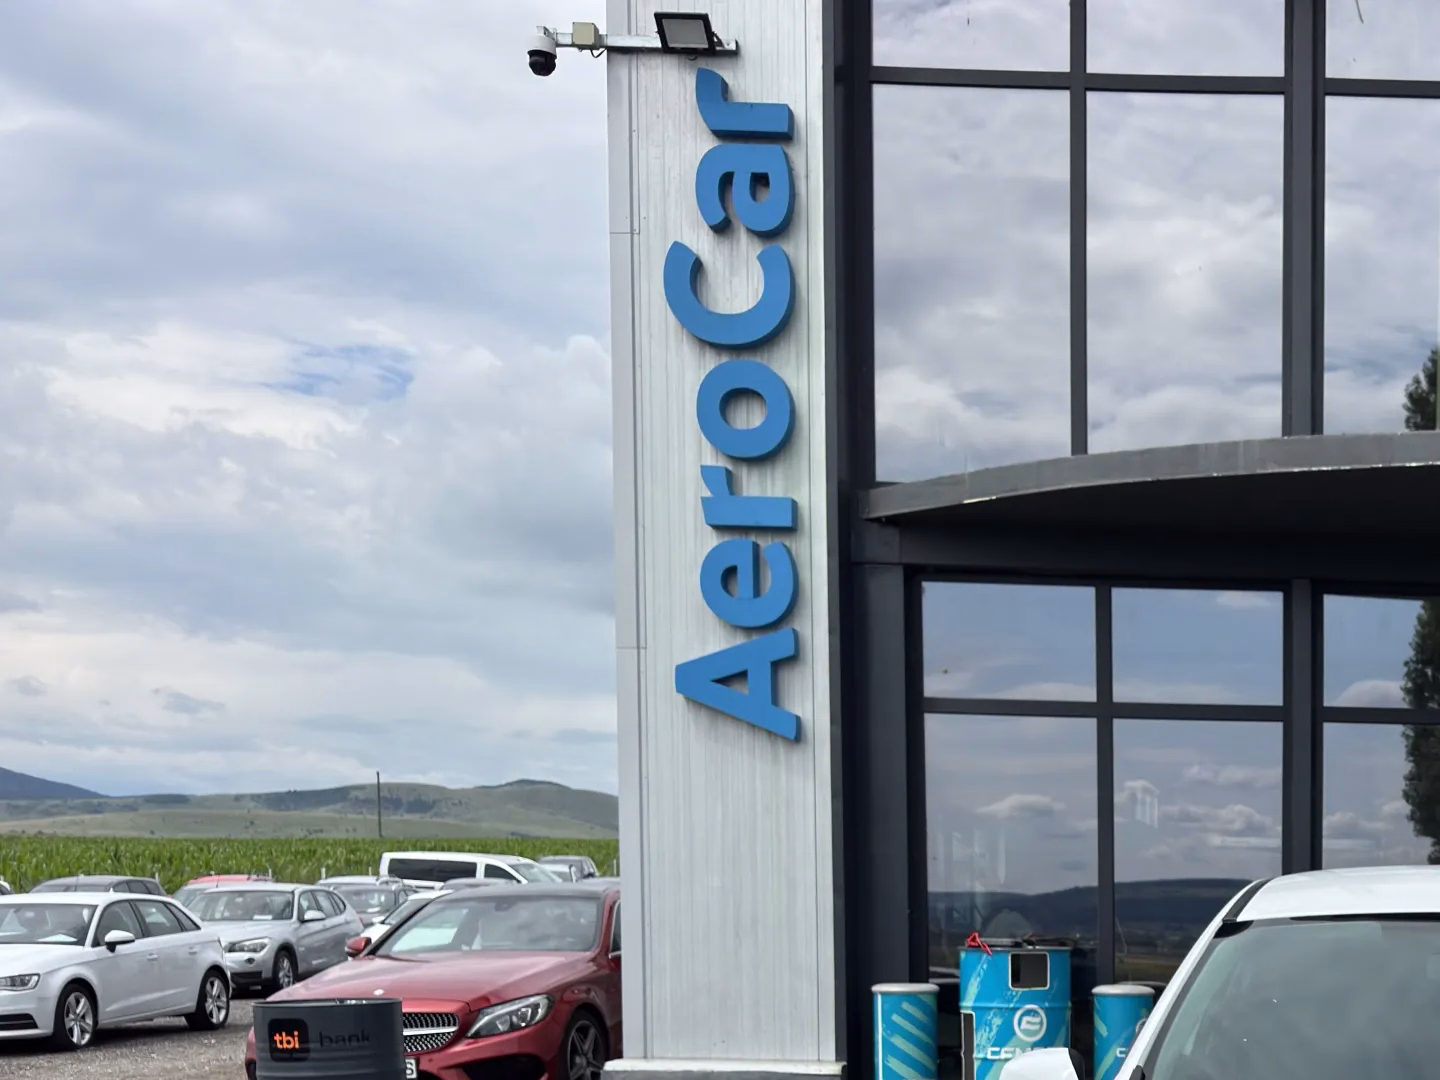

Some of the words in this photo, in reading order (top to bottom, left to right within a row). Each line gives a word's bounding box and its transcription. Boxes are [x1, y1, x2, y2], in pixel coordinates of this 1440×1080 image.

[663, 66, 799, 743] AeroCar
[274, 1031, 300, 1049] tbi
[319, 1029, 370, 1048] bank
